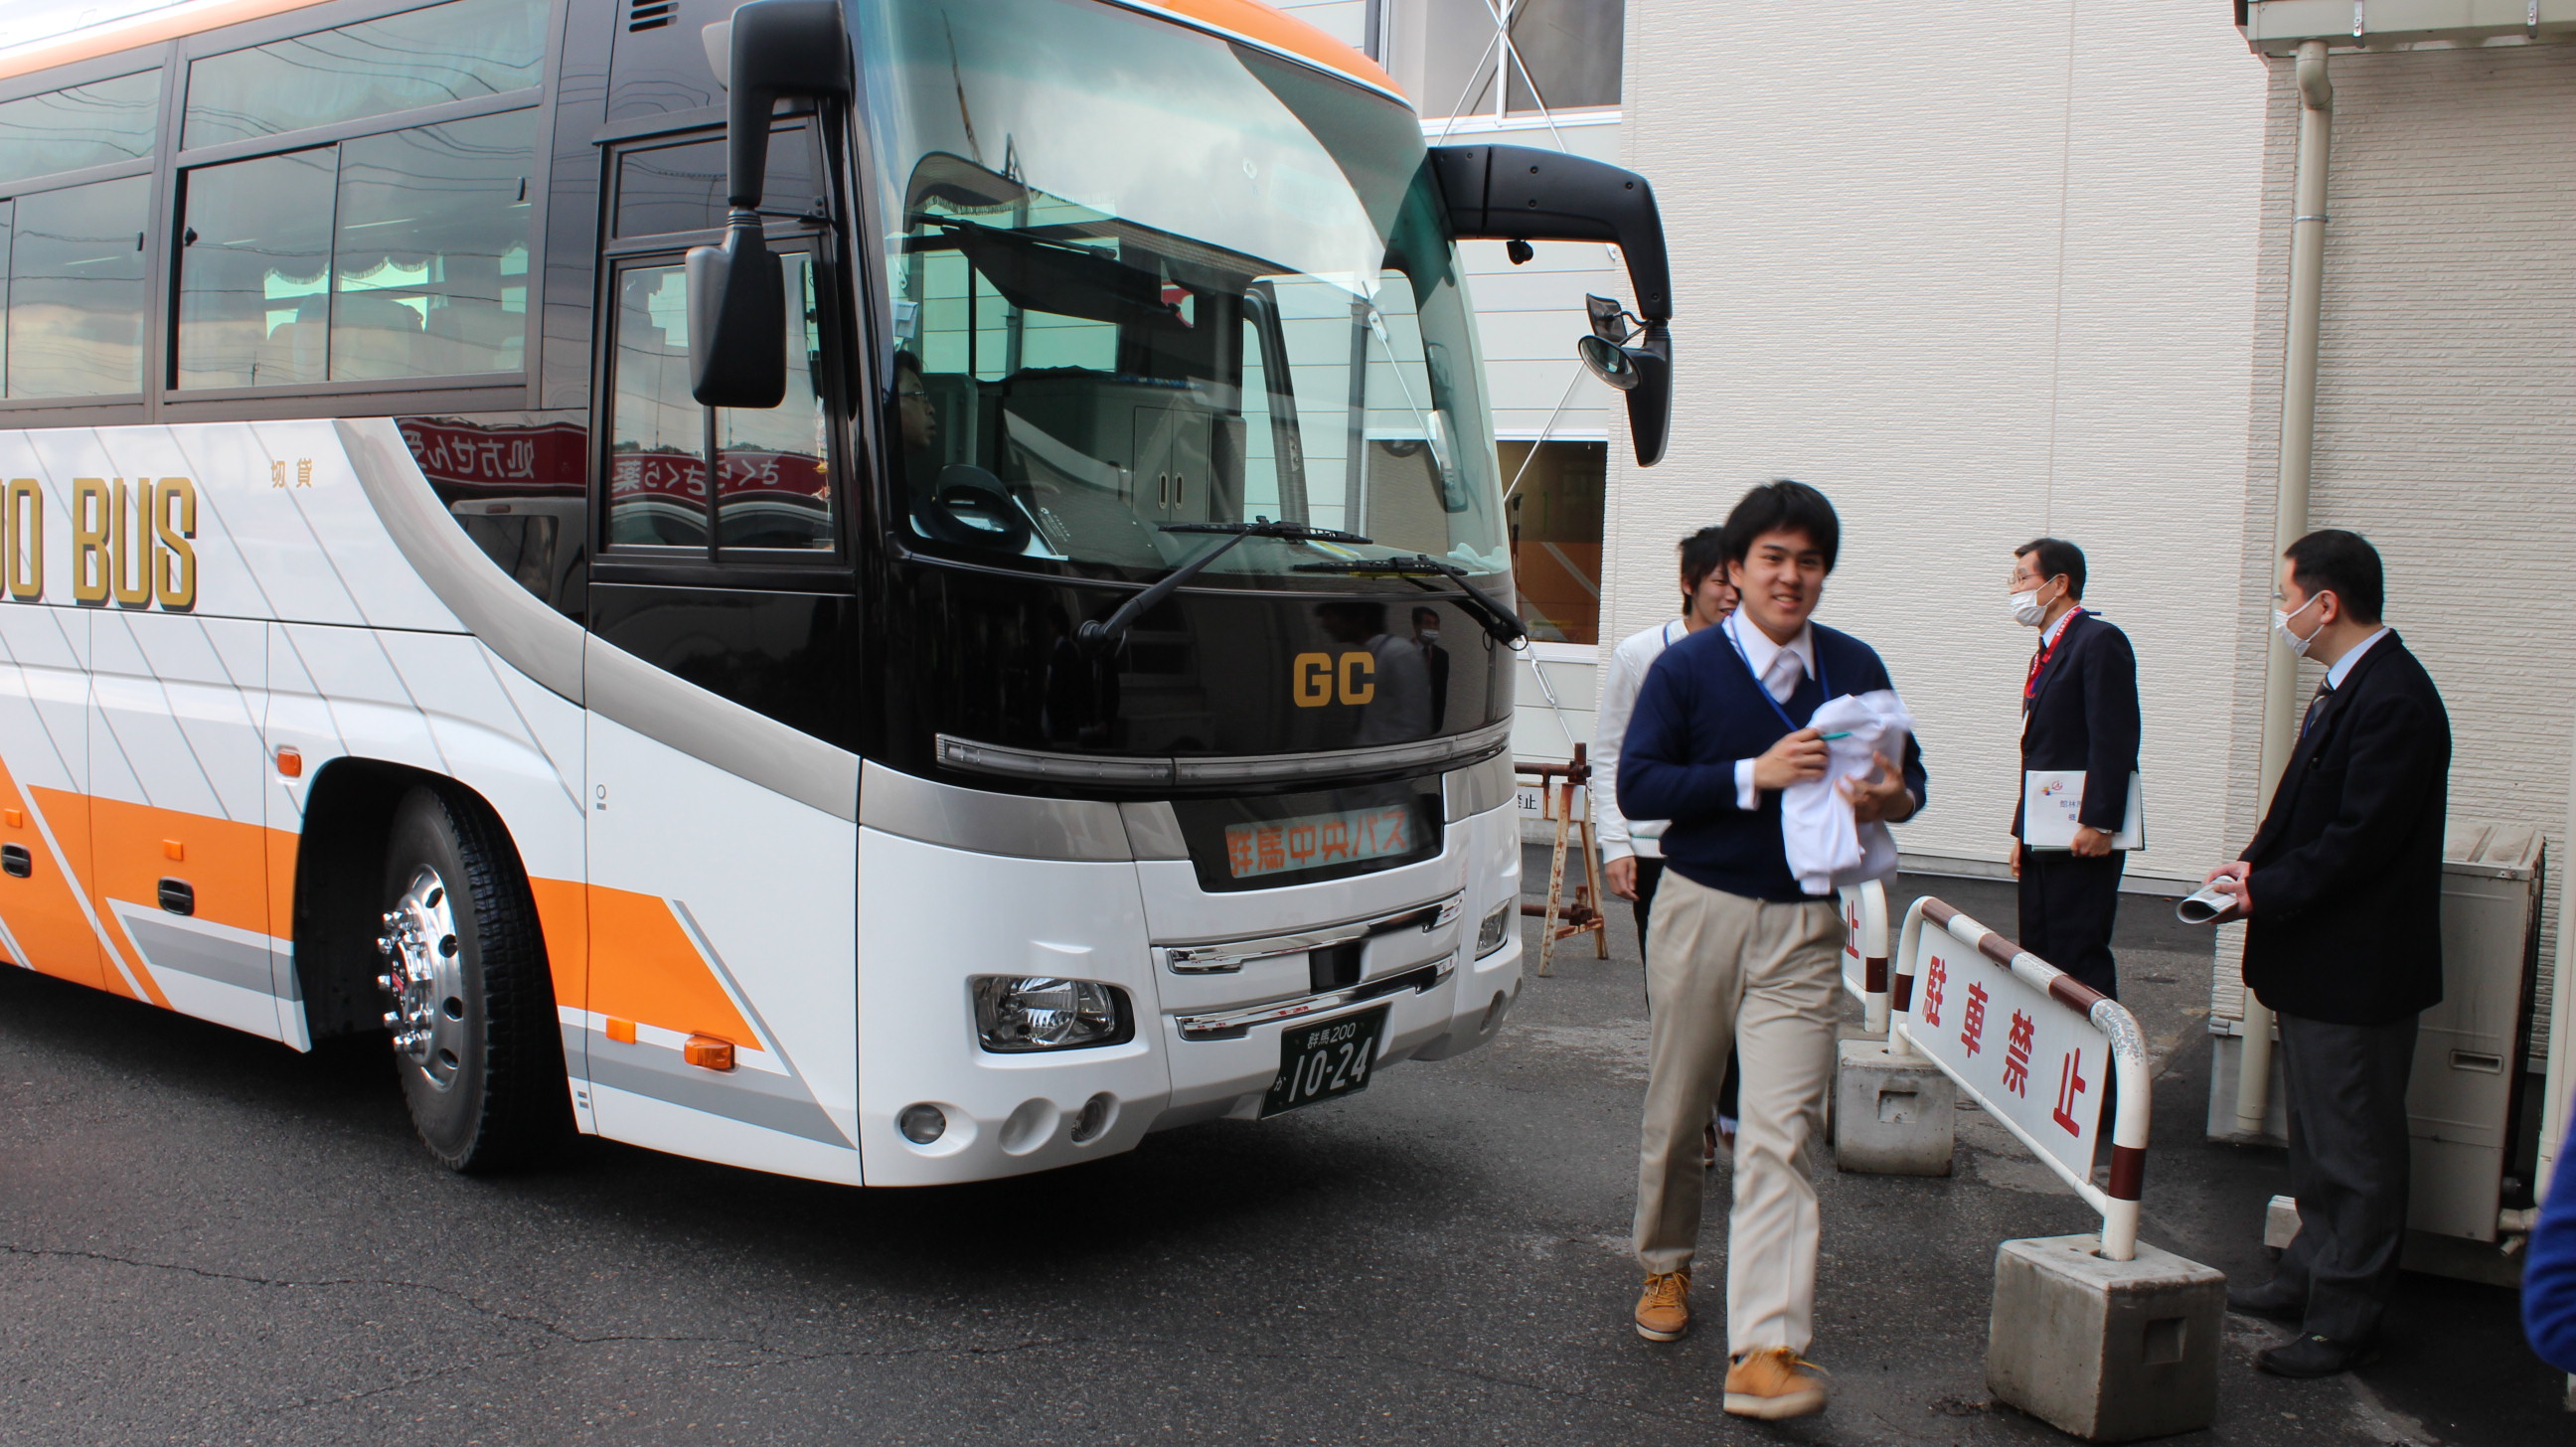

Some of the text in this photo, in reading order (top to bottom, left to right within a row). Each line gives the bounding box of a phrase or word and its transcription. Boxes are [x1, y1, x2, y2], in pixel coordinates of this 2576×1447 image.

[0, 477, 197, 613] O BUS
[1293, 651, 1374, 708] GC
[1225, 809, 1407, 877] 群馬中央バス
[1288, 1037, 1372, 1103] 10-24
[1922, 955, 2086, 1138] 駐車禁止
